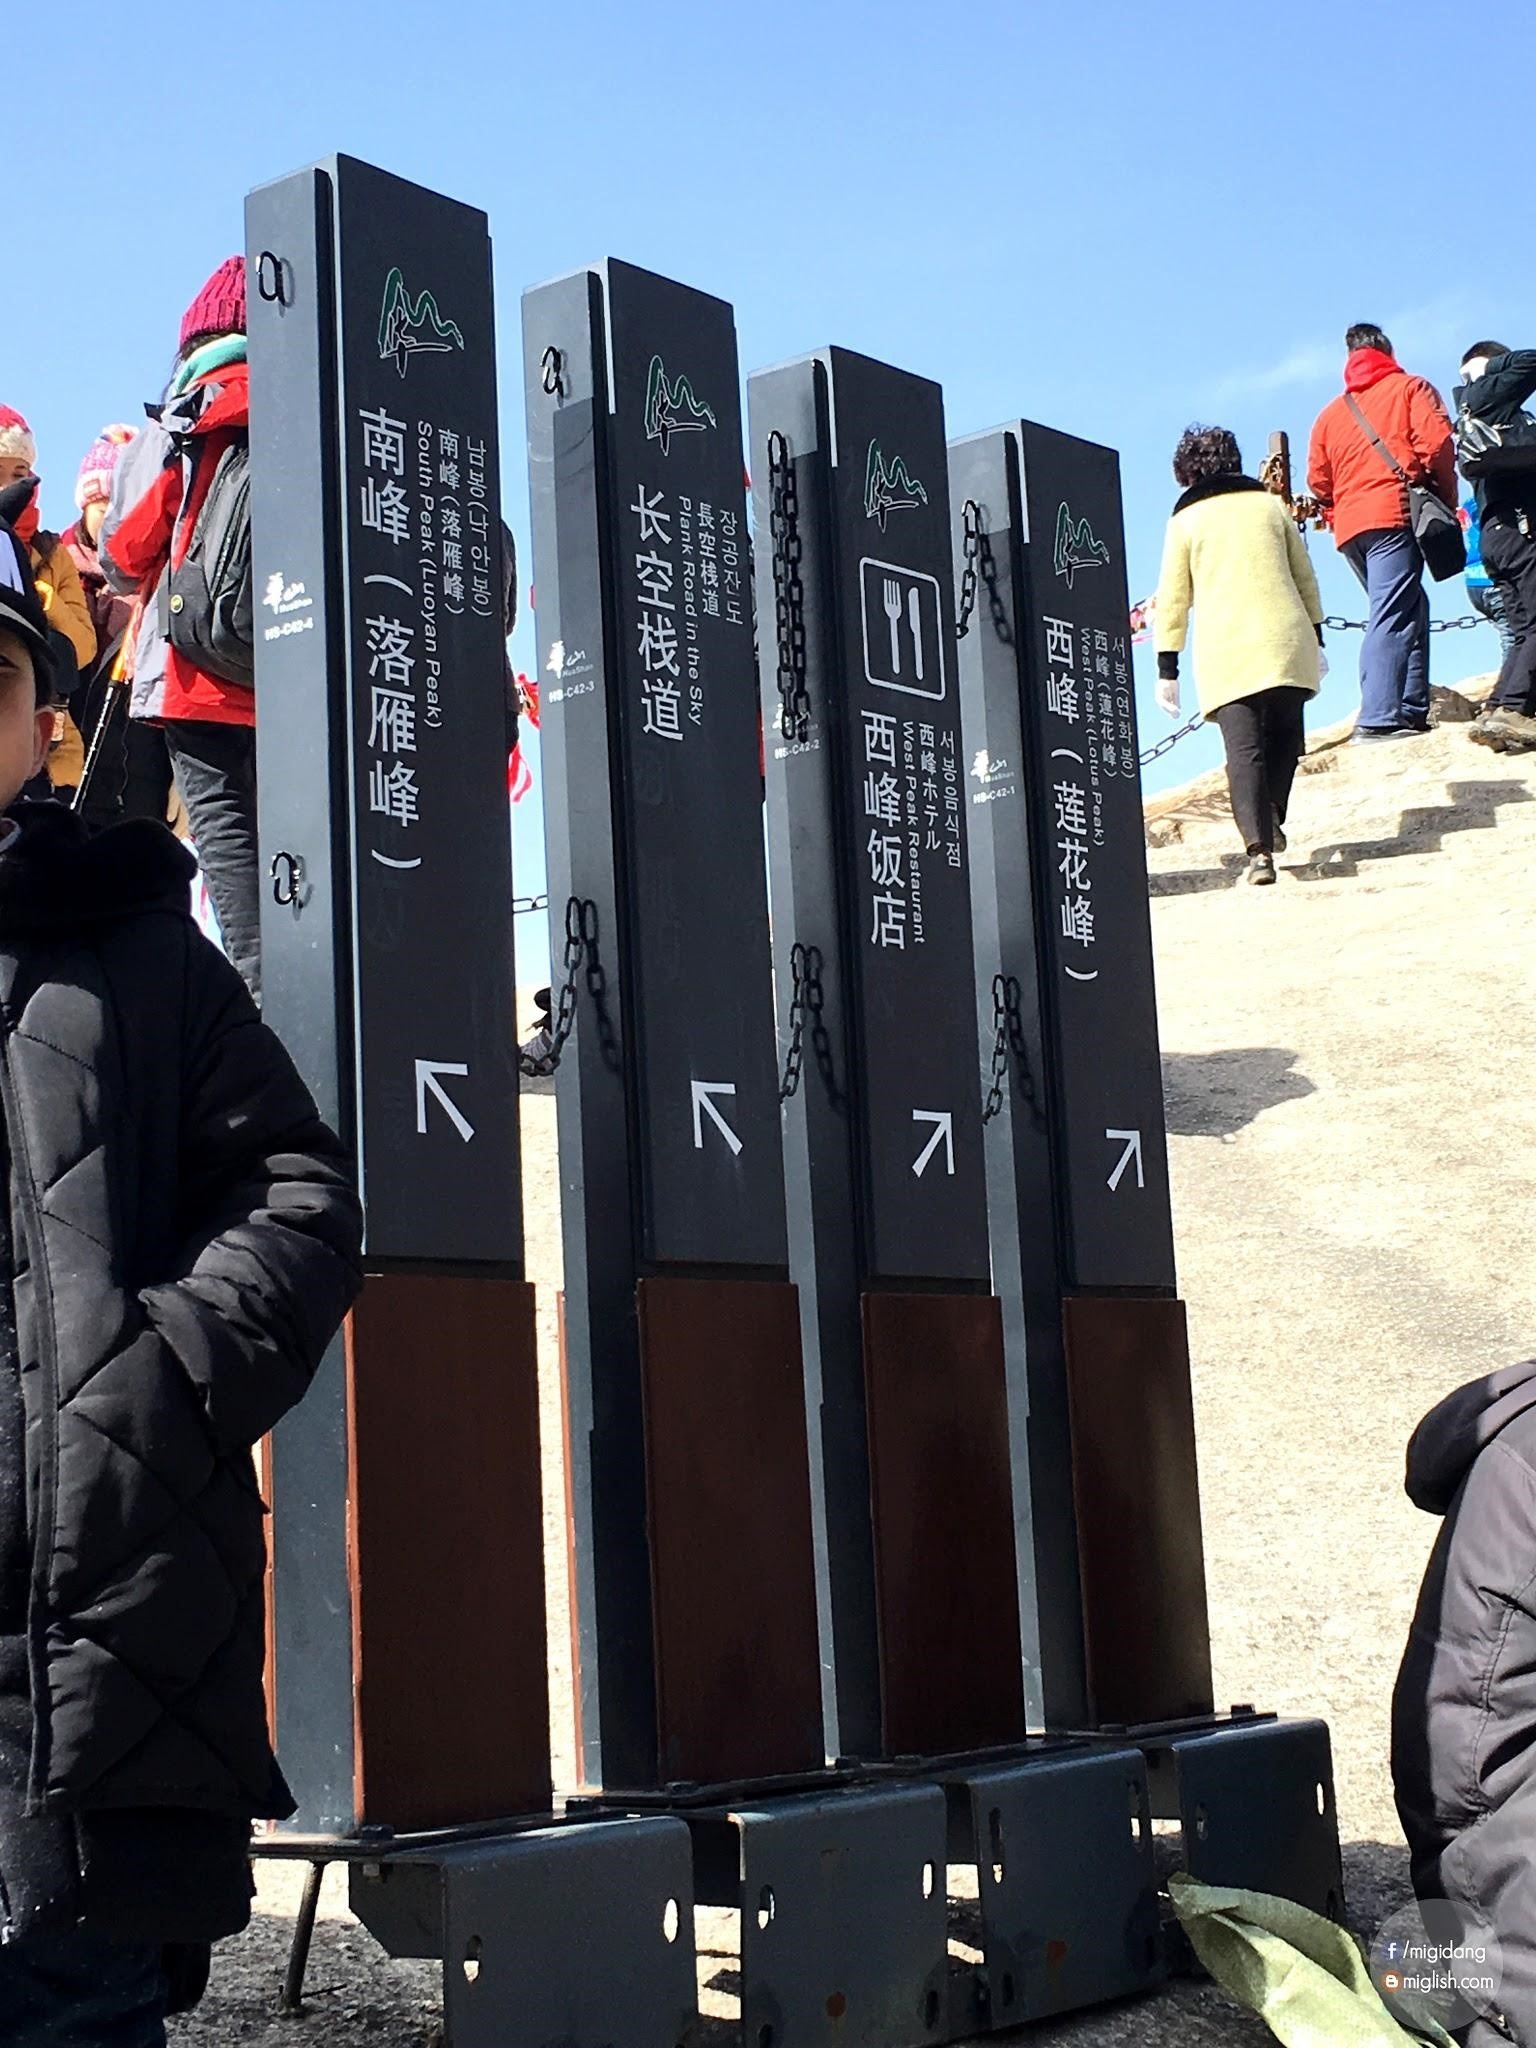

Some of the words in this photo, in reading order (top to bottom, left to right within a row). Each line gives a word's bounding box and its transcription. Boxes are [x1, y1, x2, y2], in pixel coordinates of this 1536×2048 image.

[417, 420, 434, 488] South
[419, 493, 436, 553] Peak
[466, 435, 493, 616] 남봉(낙안봉)
[679, 495, 694, 555] Plank
[682, 560, 698, 617] Road
[719, 509, 743, 625] 장공잔도
[418, 558, 437, 653] (Luoyan
[630, 483, 683, 742] 长空栈道
[685, 621, 699, 640] in
[687, 646, 700, 679] the
[1080, 627, 1092, 673] West
[423, 658, 443, 728] Peak)
[688, 685, 703, 726] Sky
[1083, 677, 1096, 723] Peak
[1112, 636, 1136, 779] 서봉(연화봉)
[902, 721, 915, 770] West
[1085, 728, 1099, 786] (Lotus
[905, 776, 919, 826] Peak
[918, 722, 941, 851] 西峰ホテル
[940, 730, 961, 868] 서봉음식점
[860, 708, 906, 950] 西峰饭店
[1092, 791, 1104, 846] Peak)
[908, 831, 926, 944] Restaurant
